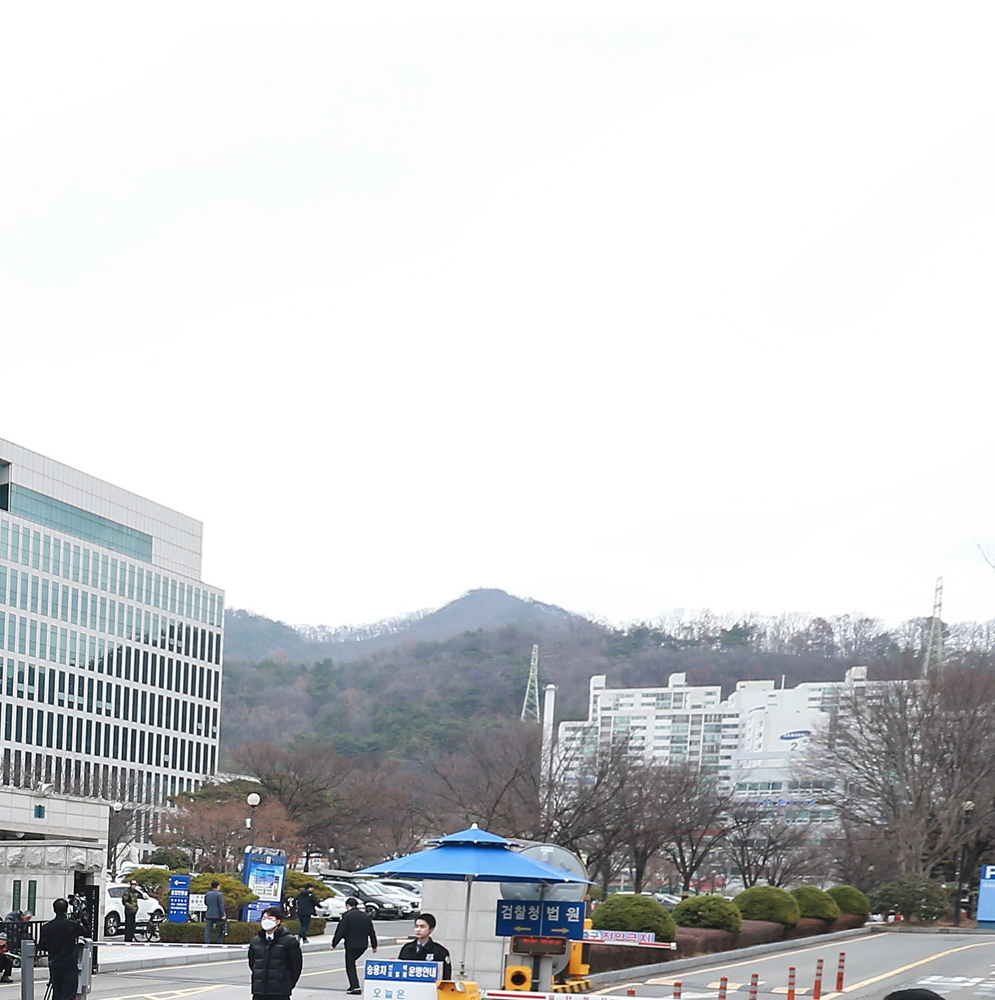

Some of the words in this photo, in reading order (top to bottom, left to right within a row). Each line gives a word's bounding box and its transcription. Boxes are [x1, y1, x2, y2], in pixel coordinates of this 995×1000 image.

[501, 904, 540, 921] 검찰청
[546, 905, 580, 923] 법원
[603, 932, 652, 943] 진입금지
[366, 964, 387, 976] 승용차
[408, 965, 437, 978] 운행안내
[372, 987, 406, 1000] 오늘은
